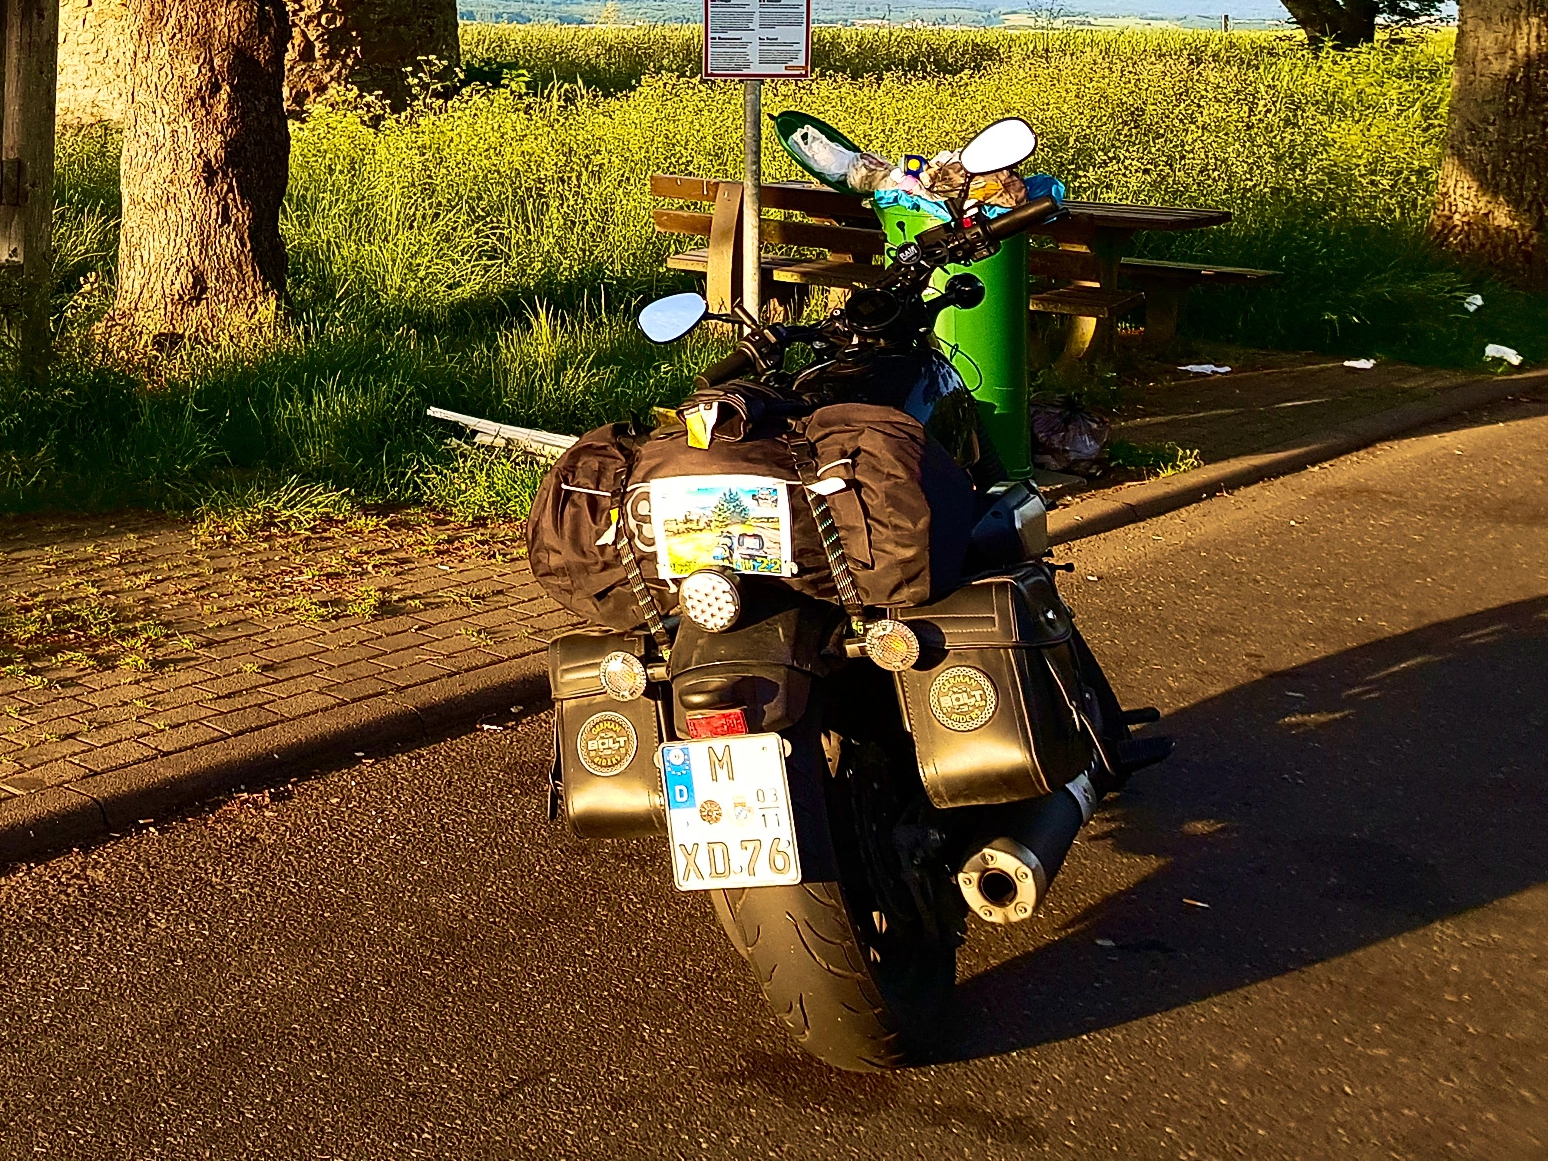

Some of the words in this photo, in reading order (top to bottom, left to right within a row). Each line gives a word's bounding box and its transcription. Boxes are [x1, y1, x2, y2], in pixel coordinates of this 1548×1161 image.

[940, 676, 977, 692] GERMAN
[940, 690, 984, 707] BOLT
[951, 709, 981, 723] RIDERS
[587, 736, 628, 751] BOLT
[708, 745, 735, 782] M
[674, 785, 689, 803] D
